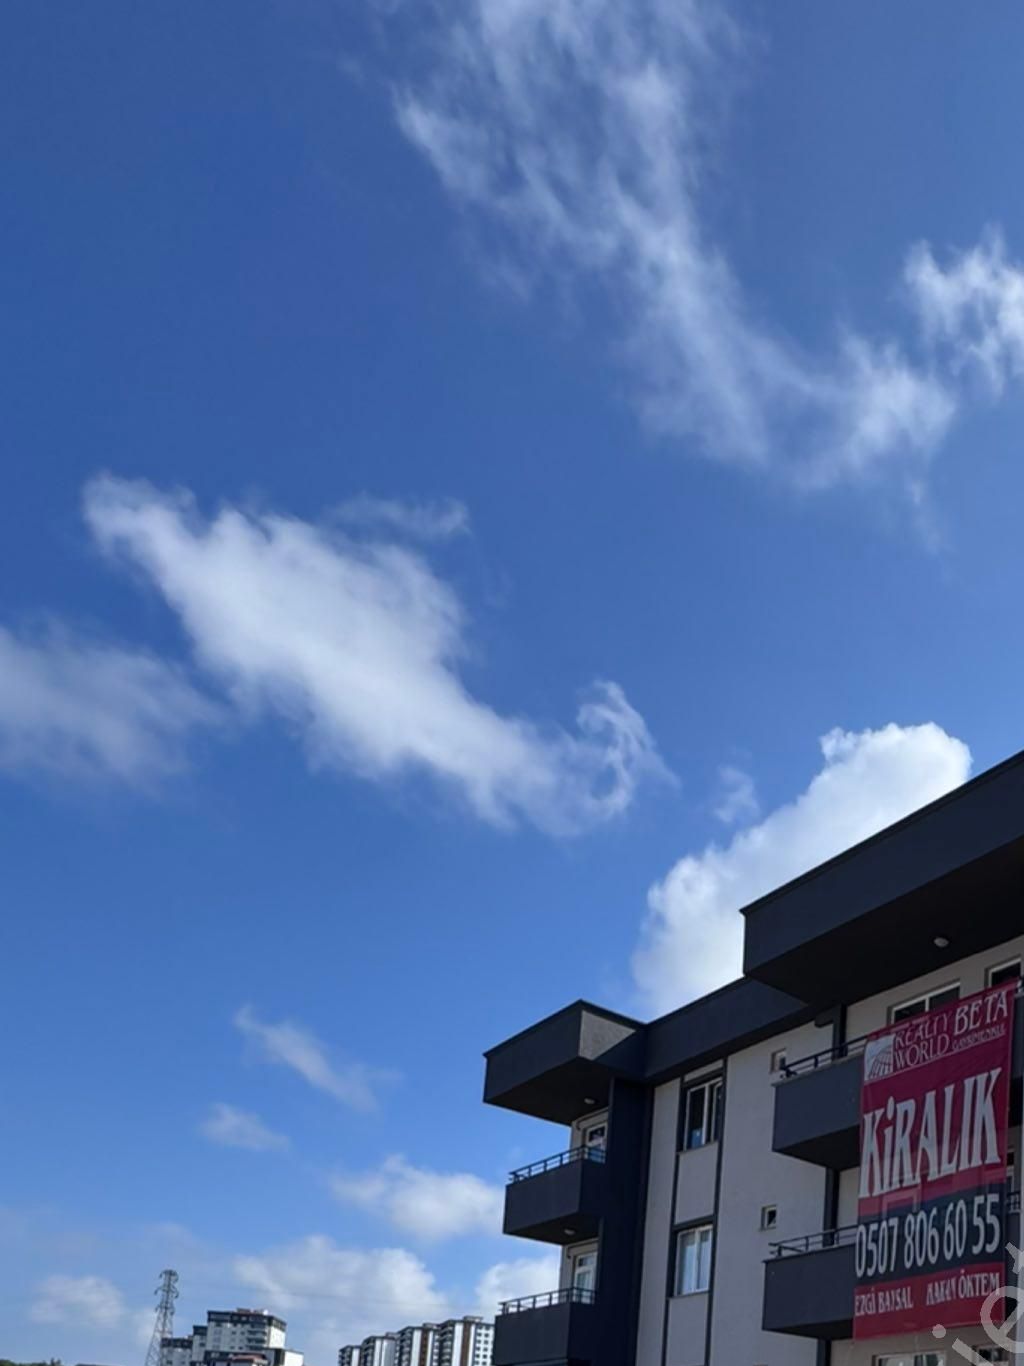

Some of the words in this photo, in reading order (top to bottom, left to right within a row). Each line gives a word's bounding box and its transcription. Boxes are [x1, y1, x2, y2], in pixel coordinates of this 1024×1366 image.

[895, 1010, 952, 1049] REALTY
[954, 989, 1008, 1036] BETA
[894, 1032, 951, 1070] WORLD
[855, 1216, 899, 1278] 0507
[904, 1207, 940, 1269] 806
[943, 1199, 968, 1261] 60
[972, 1193, 1000, 1254] 55
[958, 1268, 1001, 1298] ÖKTEM
